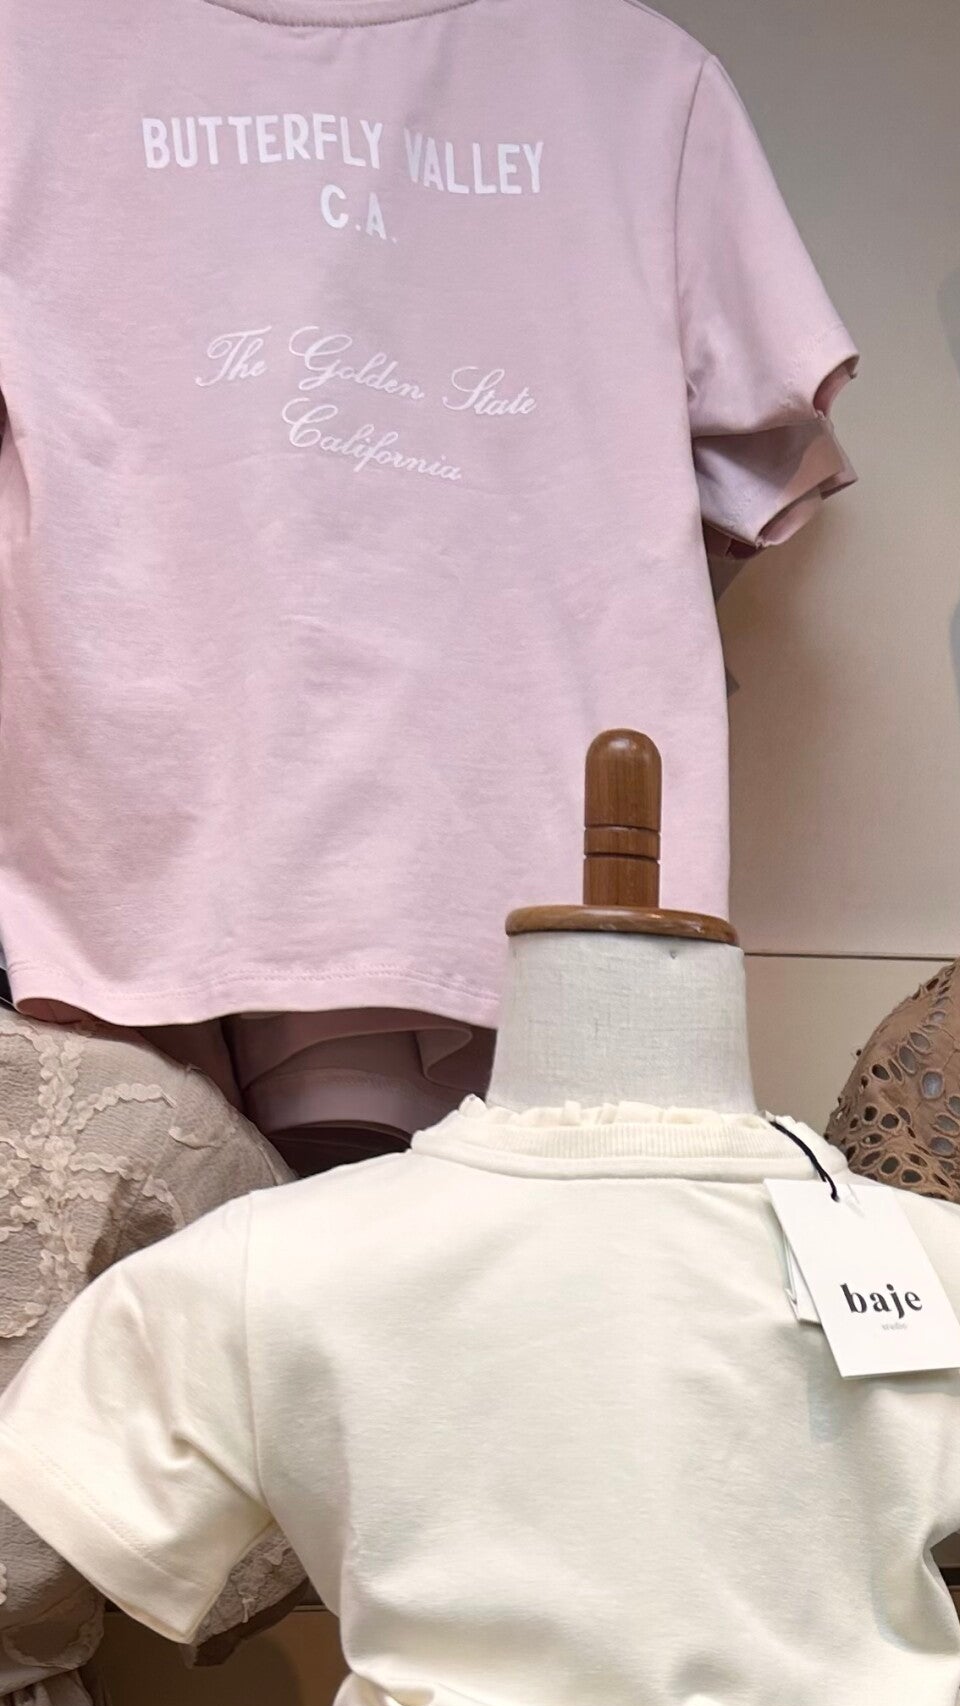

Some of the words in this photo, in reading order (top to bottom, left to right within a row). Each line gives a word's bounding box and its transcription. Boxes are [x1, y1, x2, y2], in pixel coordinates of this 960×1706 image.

[141, 113, 383, 169] BUTTERFLY
[403, 127, 544, 195] VALLEY
[320, 184, 398, 243] C.A.
[195, 326, 272, 386] The
[288, 326, 425, 399] Golden
[442, 366, 537, 415] State
[281, 397, 462, 481] California
[840, 1283, 923, 1319] baje
